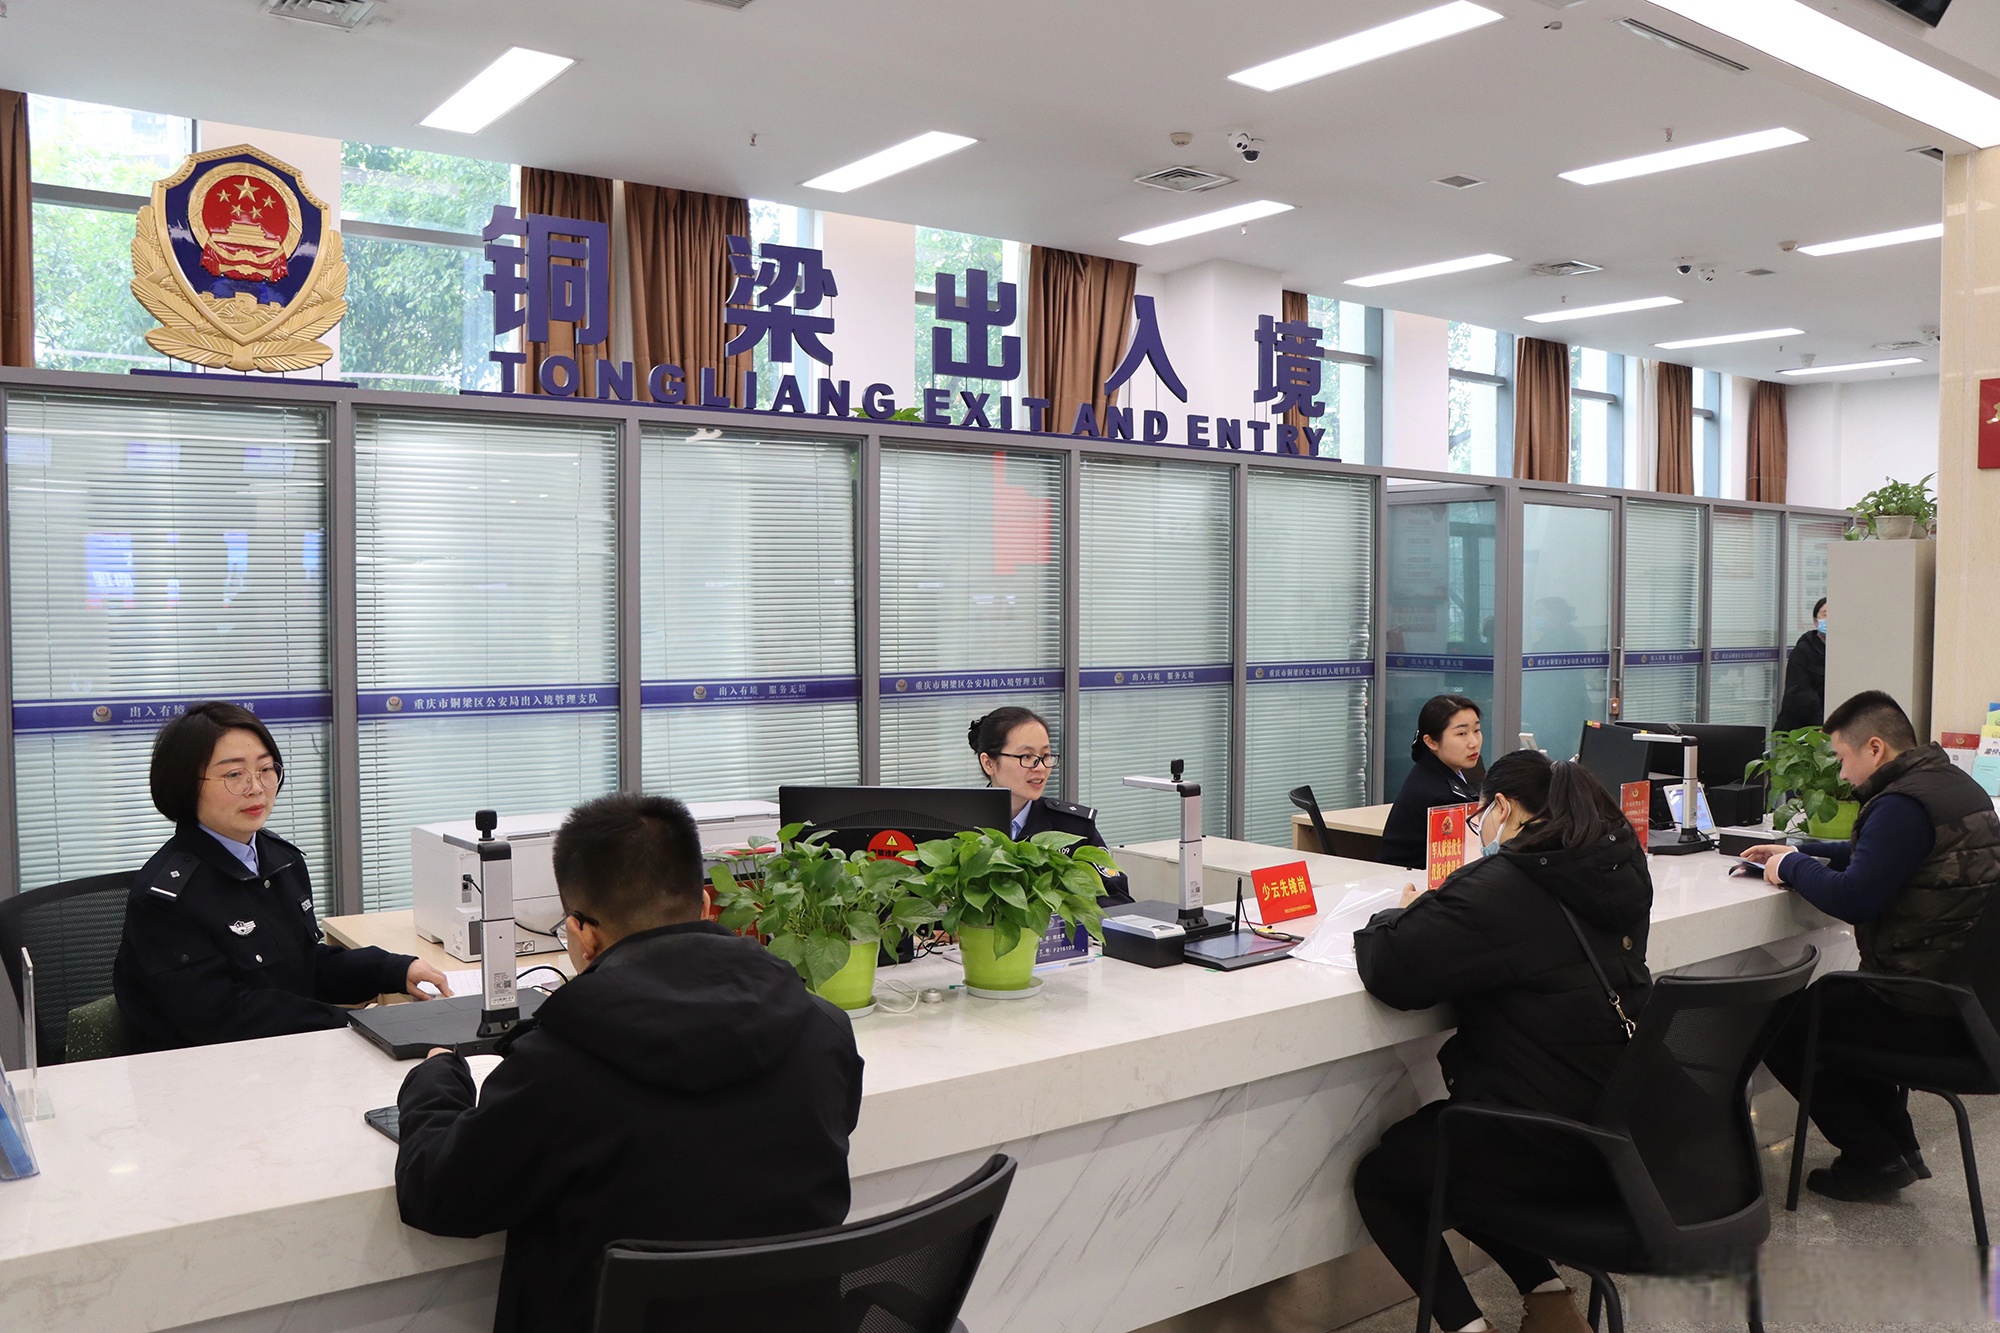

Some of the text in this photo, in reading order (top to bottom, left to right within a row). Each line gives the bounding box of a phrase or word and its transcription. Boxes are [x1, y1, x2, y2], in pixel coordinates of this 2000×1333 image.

[489, 351, 1326, 457] TONGLIANG EXIT AND ENTRY
[915, 677, 1046, 690] 重庆市铜梁区公安局出入境管理支队
[1132, 671, 1195, 681] 出入有境 服务无境
[719, 684, 807, 696] 出入有境 服务无境
[413, 693, 598, 710] 重庆市铜梁区公安局出入境管理支队
[1262, 876, 1307, 902] 少云先锋岗
